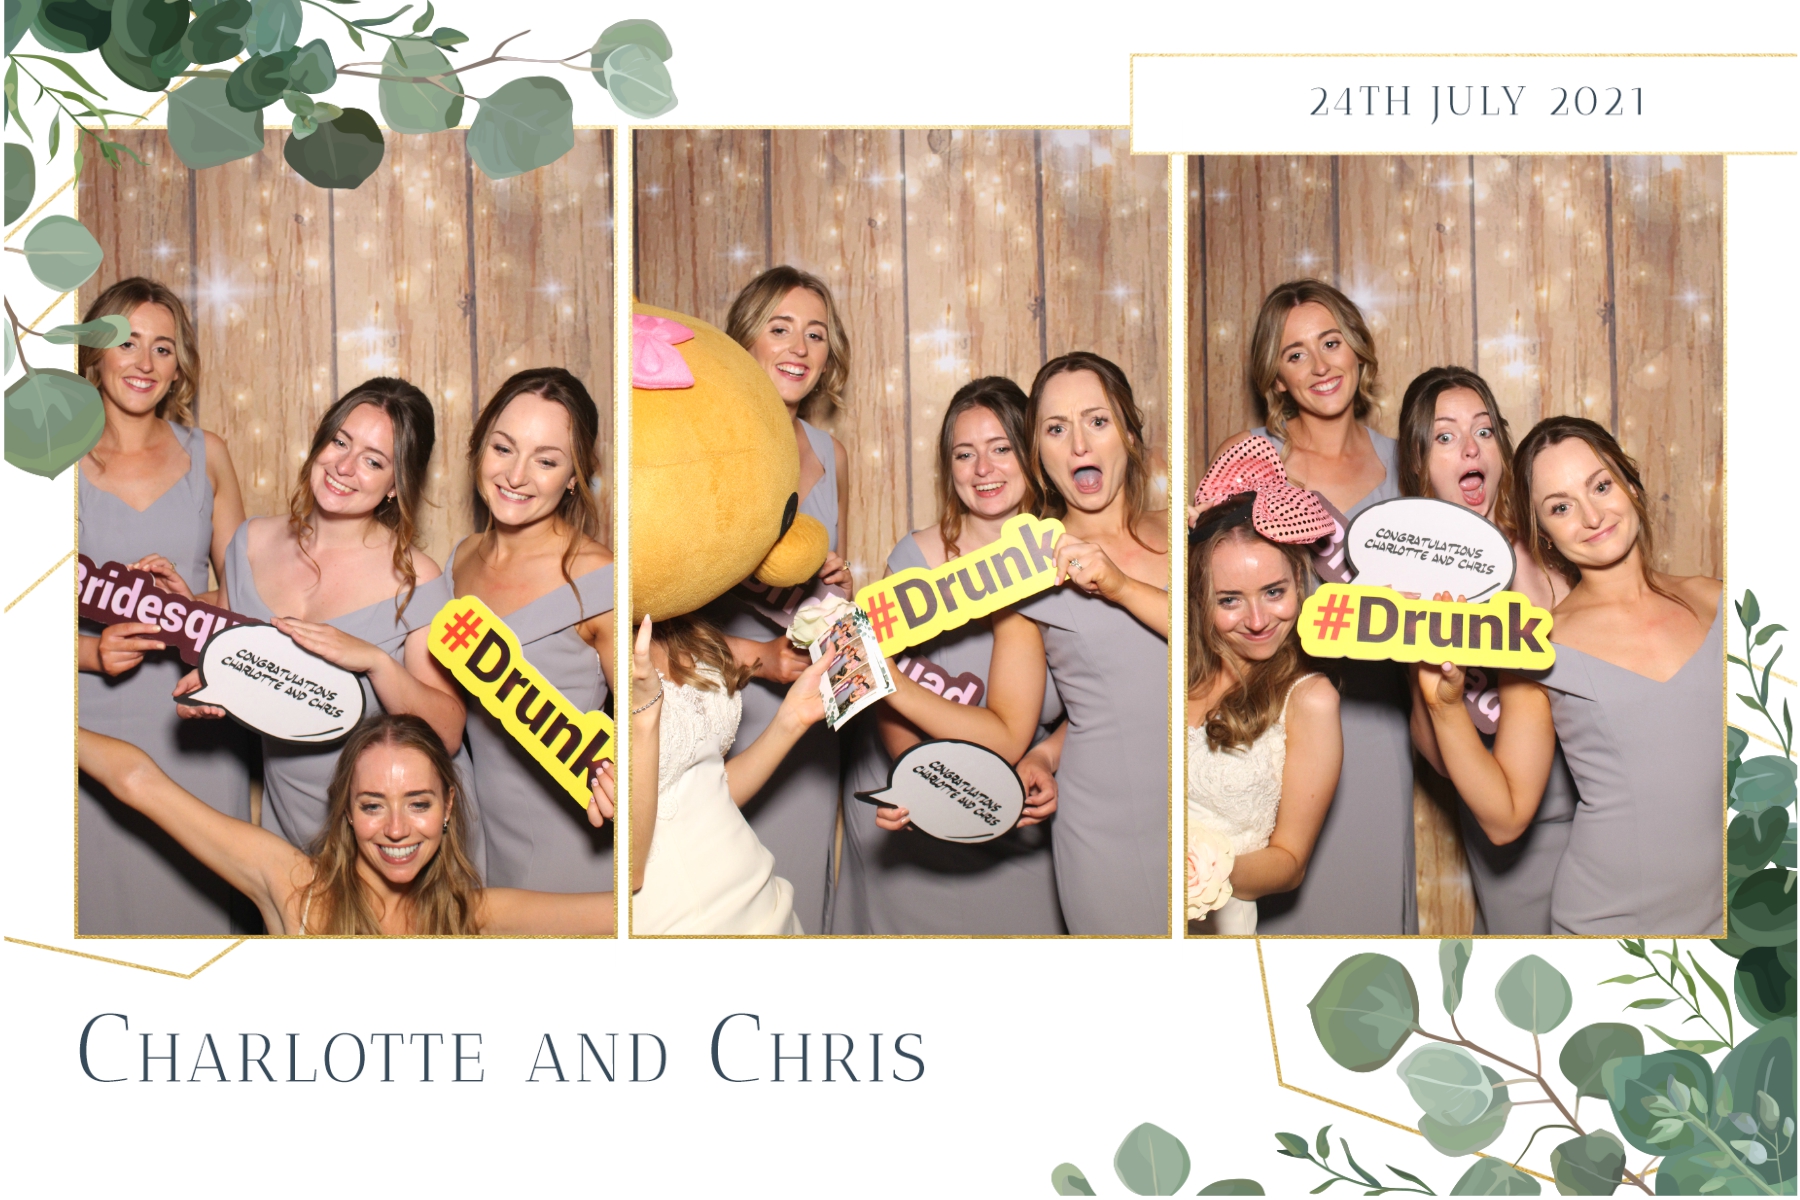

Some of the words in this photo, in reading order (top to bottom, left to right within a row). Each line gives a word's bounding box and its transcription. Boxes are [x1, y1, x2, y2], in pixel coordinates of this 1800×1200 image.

[1364, 539, 1428, 561] CHARLOTTE
[1431, 553, 1455, 567] AND
[1457, 559, 1496, 576] CHRIS
[1375, 528, 1483, 559] CONGRATULATIONS
[867, 523, 1055, 643] #Drunk
[1313, 593, 1546, 653] #Drunk
[221, 656, 282, 691] CHARLOTTE
[284, 686, 308, 701] AND
[308, 698, 345, 719] CHRIS
[235, 649, 338, 702] CONGRATULATIONS
[440, 608, 614, 790] #Drunk
[912, 765, 961, 799] CHARLOTTE
[957, 796, 976, 809] AND
[973, 808, 1001, 826] CHRIS
[928, 761, 1002, 812] CONGRATULATIONS
